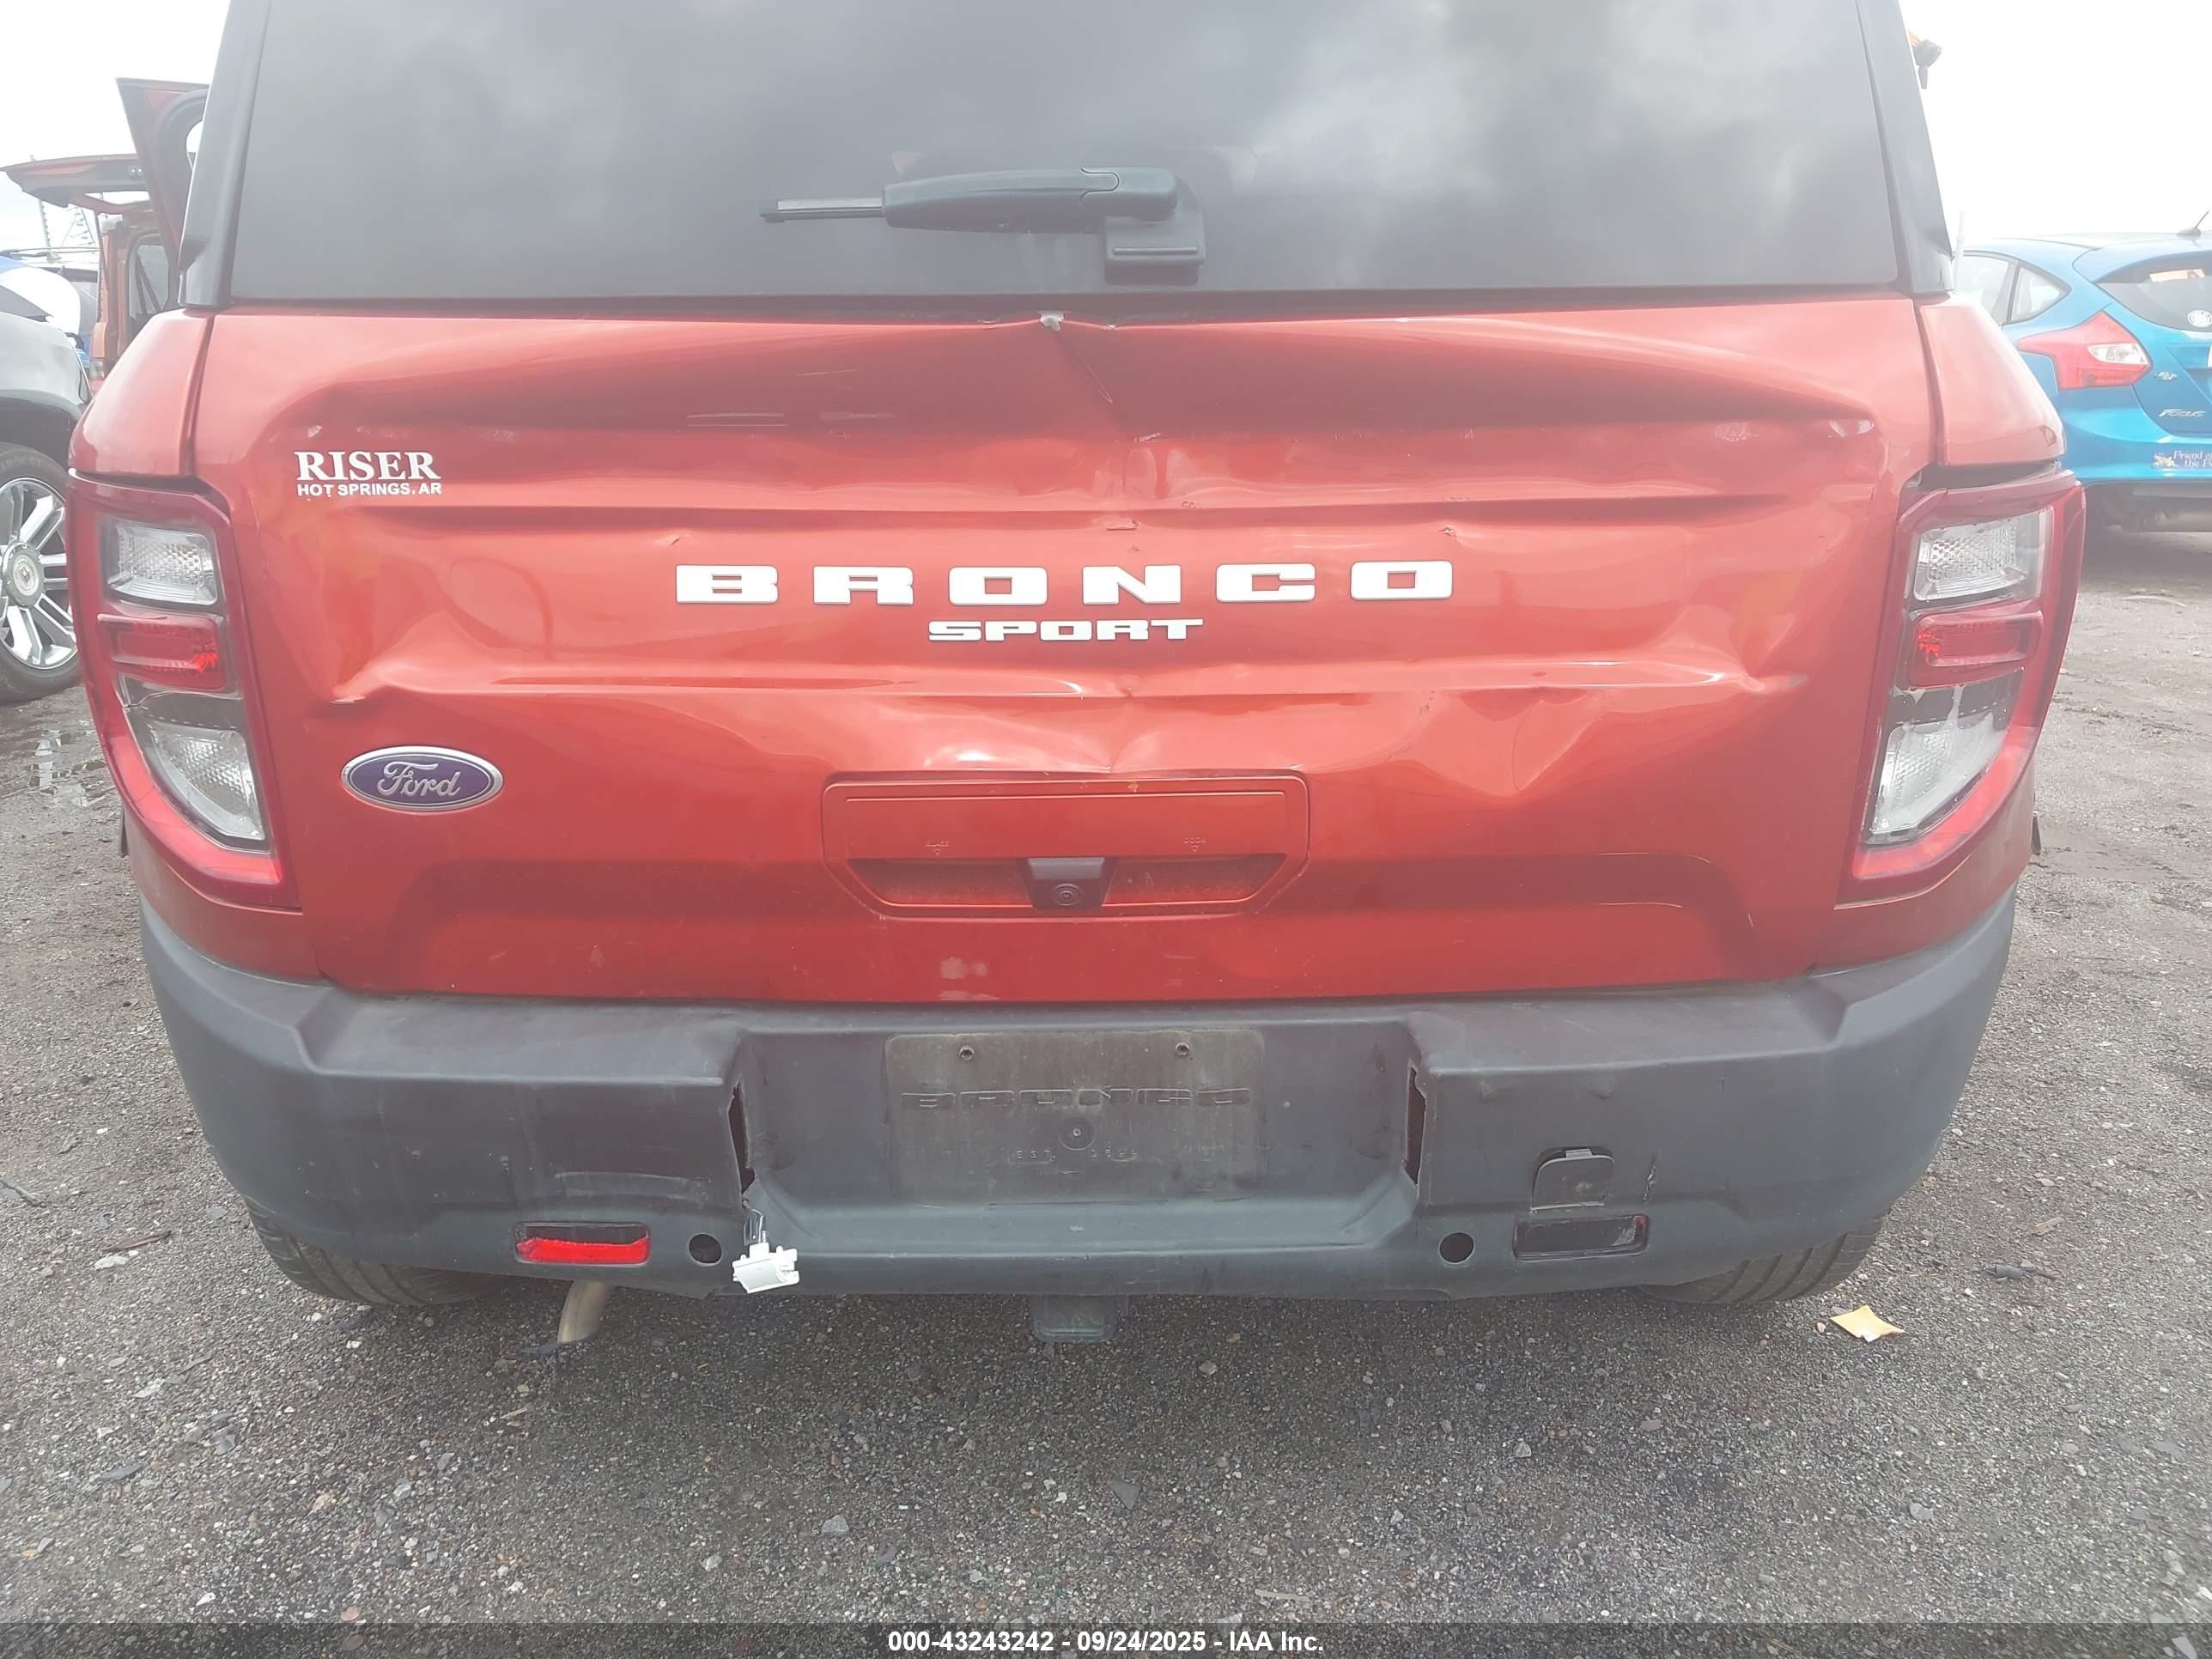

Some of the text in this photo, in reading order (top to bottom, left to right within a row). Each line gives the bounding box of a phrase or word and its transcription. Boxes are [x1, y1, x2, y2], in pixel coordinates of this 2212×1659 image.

[294, 451, 441, 481] RISER
[297, 483, 334, 496] HOT
[418, 483, 441, 495] AR
[676, 561, 1453, 606] BRONCO
[928, 619, 1203, 641] SPORT
[377, 761, 461, 797] Ford
